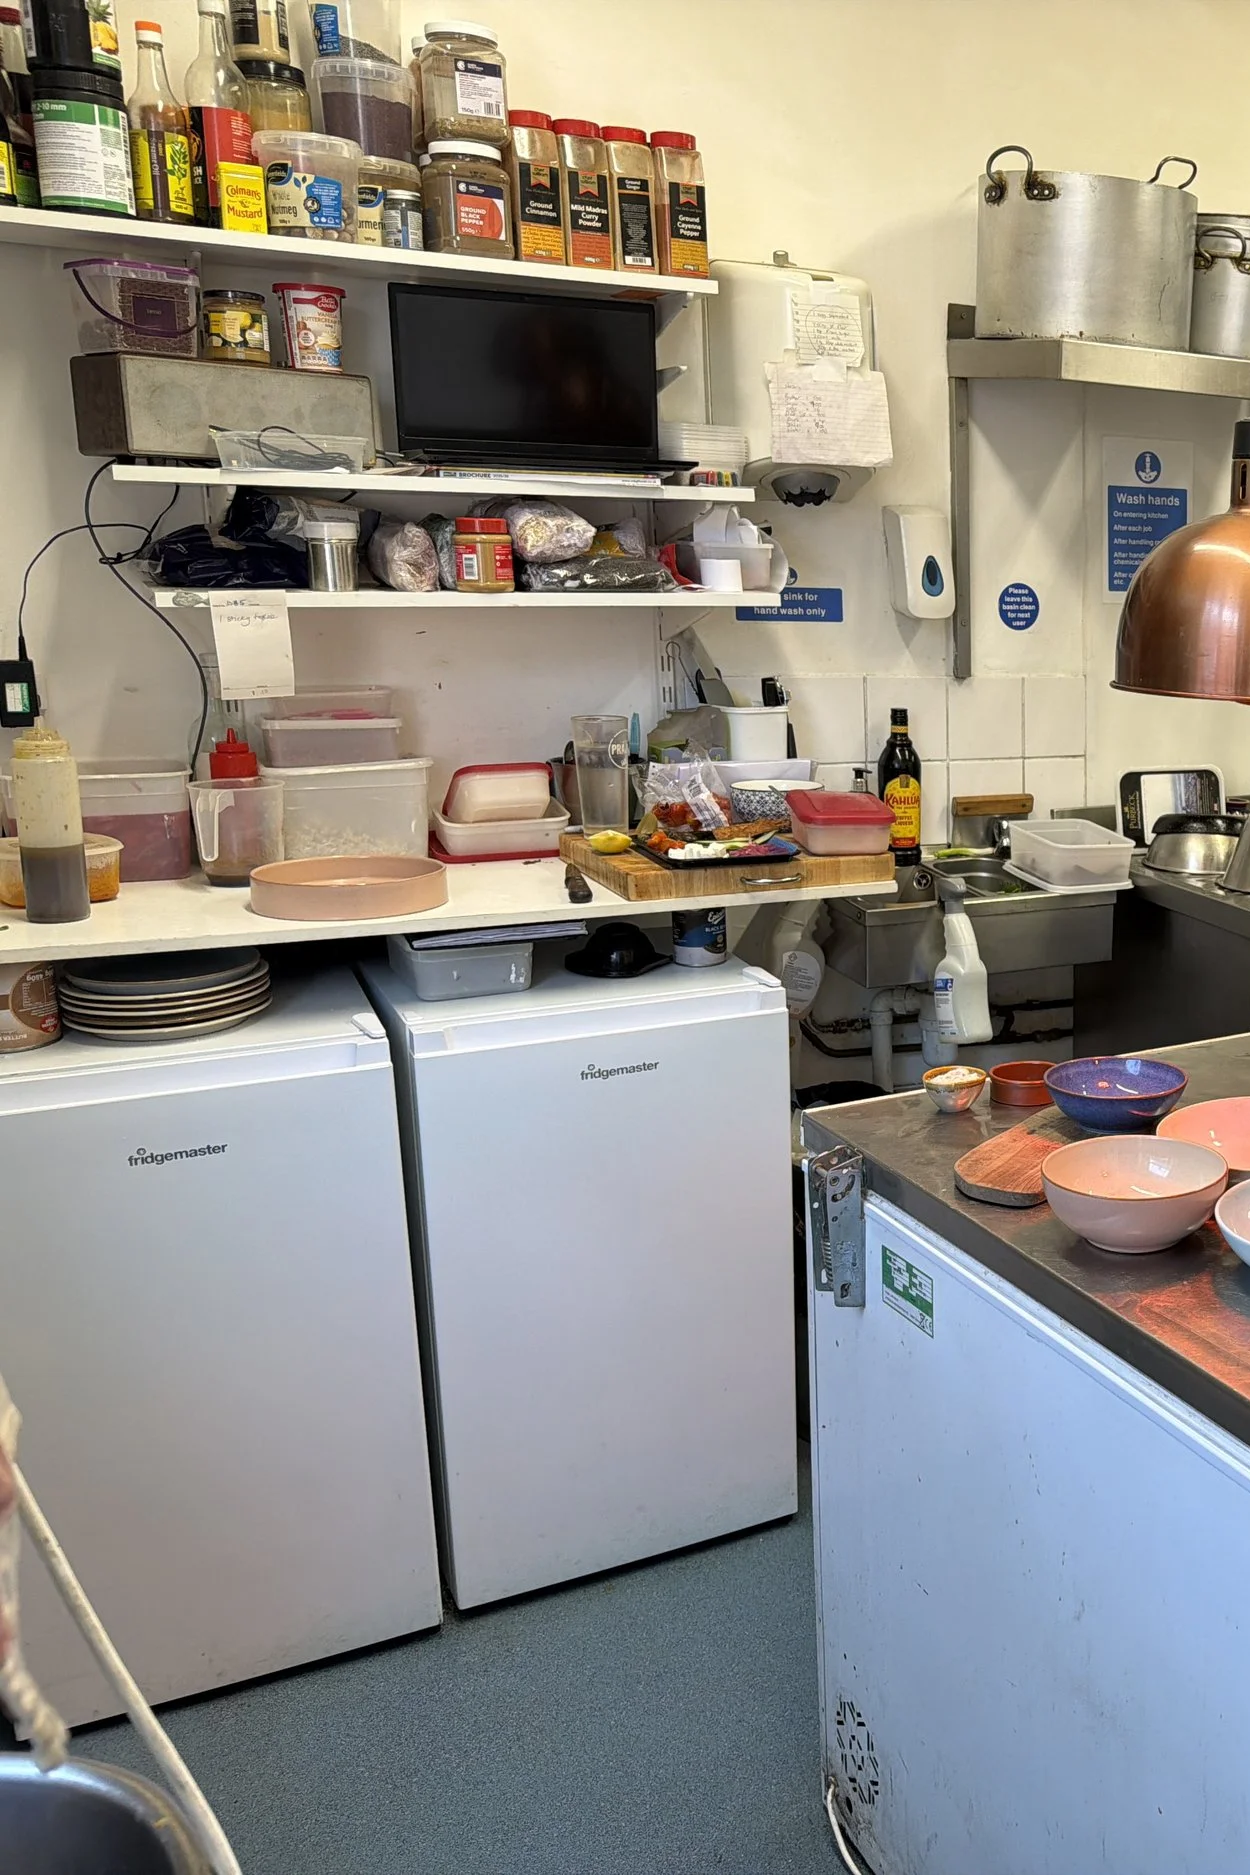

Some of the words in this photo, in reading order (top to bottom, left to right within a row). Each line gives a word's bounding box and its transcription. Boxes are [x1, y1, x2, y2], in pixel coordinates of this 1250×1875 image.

[226, 184, 262, 200] Colman's
[529, 200, 553, 209] Ground
[570, 203, 585, 211] Mild
[585, 205, 607, 215] Madras
[227, 204, 263, 218] Mustard
[271, 205, 298, 218] Nutmeg
[460, 206, 487, 215] GROUND
[525, 207, 557, 218] Cinnamon
[460, 212, 480, 220] BLACK
[581, 212, 599, 221] Curry
[678, 214, 700, 223] Ground
[460, 218, 484, 226] PEPPER
[578, 219, 602, 228] Powder
[677, 221, 701, 230] Cayenne
[679, 228, 700, 237] Pepper
[1116, 492, 1146, 505] Wash
[1147, 493, 1180, 507] hands
[1113, 510, 1122, 518] On
[1123, 511, 1147, 520] entering
[1147, 510, 1169, 519] kitchen
[1113, 524, 1128, 532] After
[1143, 525, 1153, 533] job
[1128, 538, 1154, 547] handling
[1008, 587, 1029, 595] Please
[783, 592, 803, 601] sink
[804, 592, 819, 601] for
[753, 606, 778, 615] hand
[779, 607, 804, 615] wash
[805, 607, 827, 617] only
[580, 1061, 660, 1081] fridgemaster
[127, 1143, 228, 1167] fridgemaster
